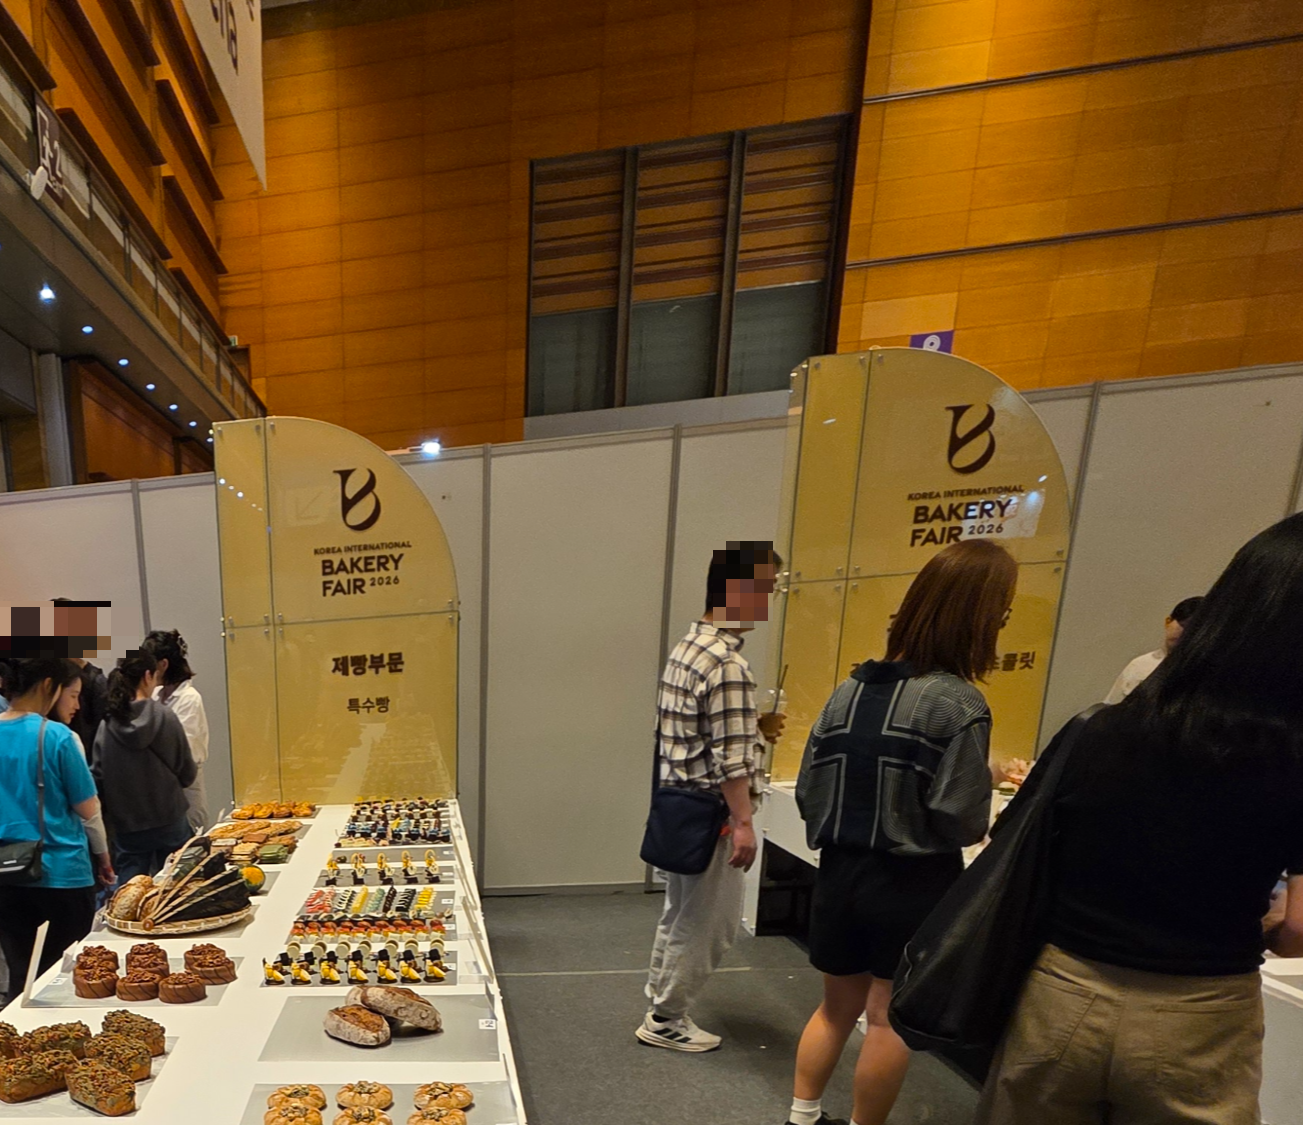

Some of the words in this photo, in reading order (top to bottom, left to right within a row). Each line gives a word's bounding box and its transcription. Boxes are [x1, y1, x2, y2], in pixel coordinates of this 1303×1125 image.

[907, 491, 941, 501] KOREA
[943, 485, 1025, 498] INTERNATIONAL
[913, 499, 1013, 524] BAKERY
[910, 526, 963, 547] FAIR
[968, 523, 1004, 535] 2026
[314, 546, 342, 555] KOREA
[344, 541, 412, 553] INTERNATIONAL
[321, 553, 404, 576] BAKERY
[322, 578, 366, 597] FAIR
[369, 576, 400, 587] 2026
[331, 652, 405, 677] 제빵부문
[347, 696, 390, 714] 특수빵
